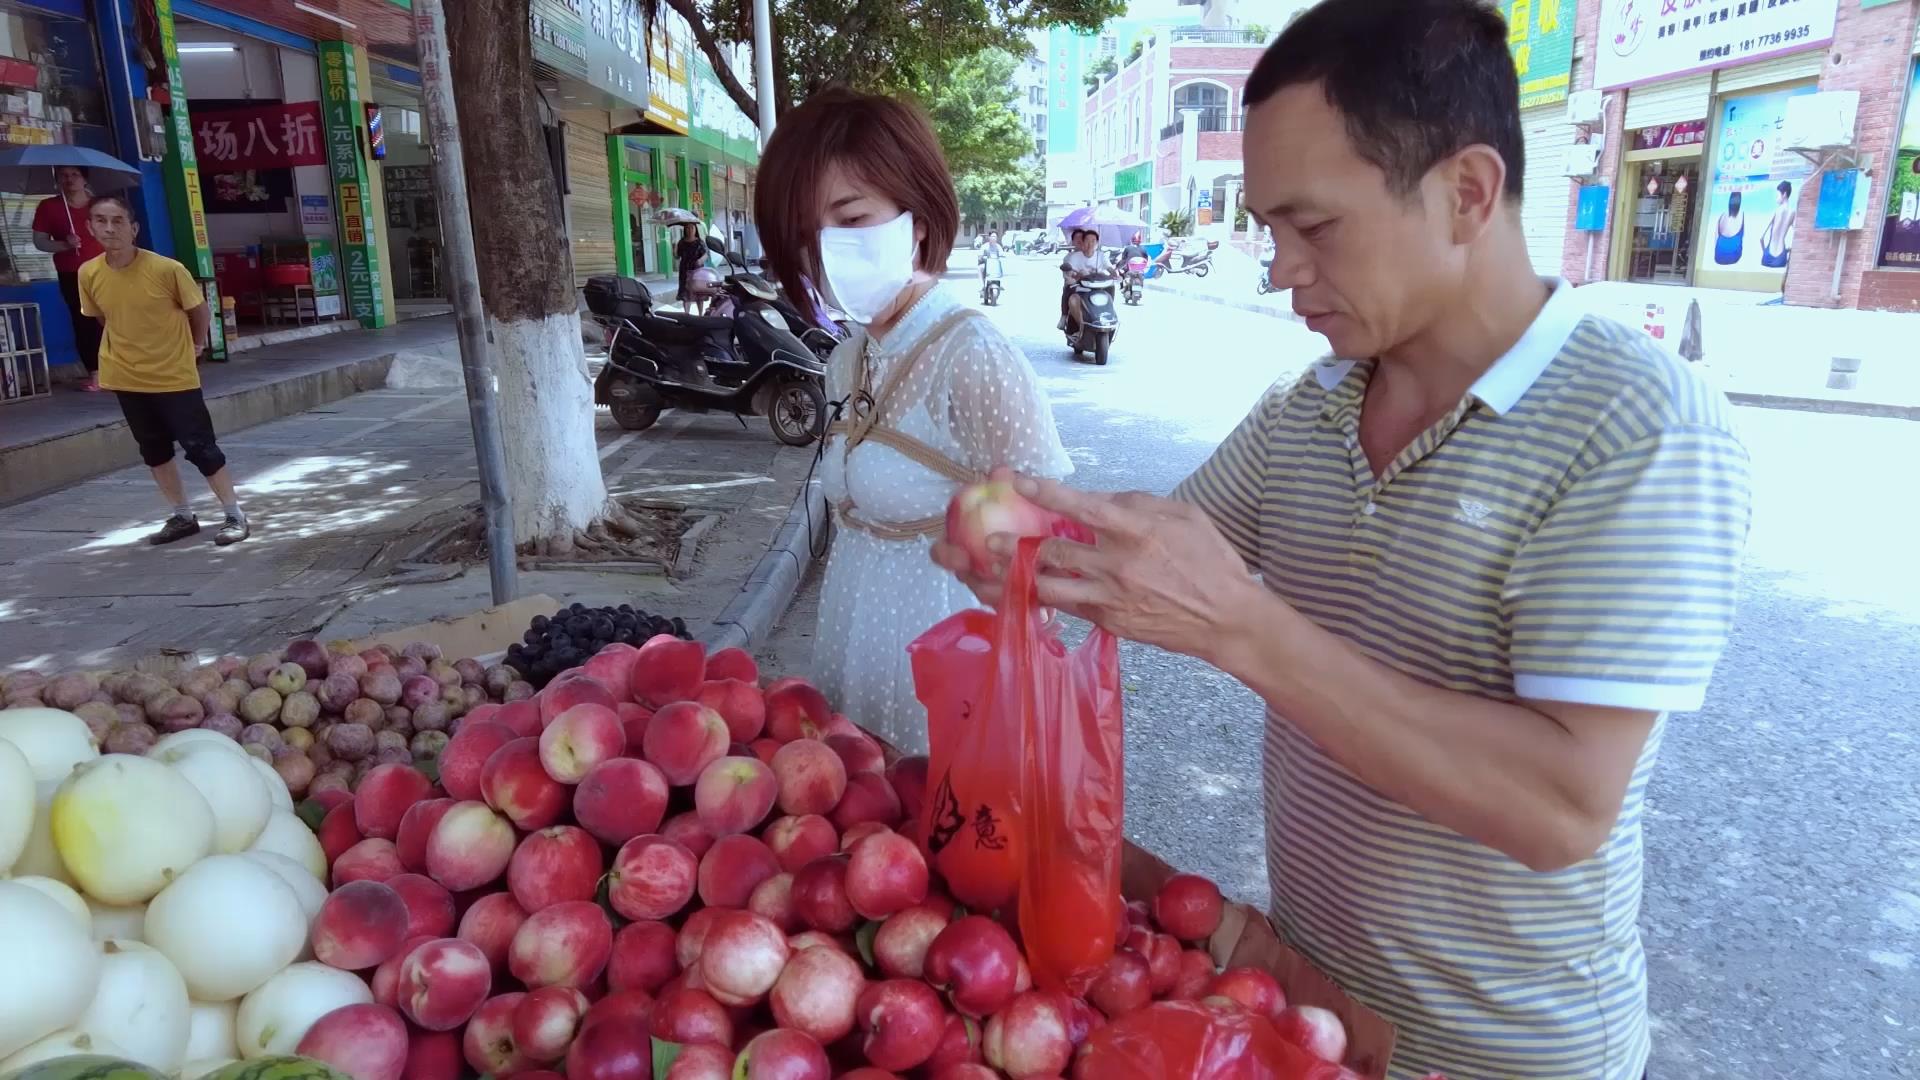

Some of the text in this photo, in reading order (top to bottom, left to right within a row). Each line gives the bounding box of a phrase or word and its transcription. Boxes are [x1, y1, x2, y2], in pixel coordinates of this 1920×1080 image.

[1739, 39, 1755, 52] 181
[1758, 32, 1782, 48] 7736
[1784, 24, 1810, 42] 9935
[326, 51, 346, 101] 零售价
[198, 112, 318, 162] 场八折
[333, 106, 357, 179] 1元系列
[187, 172, 208, 247] 工厂直销
[342, 185, 364, 243] 工厂直销
[351, 250, 374, 318] 2元三支
